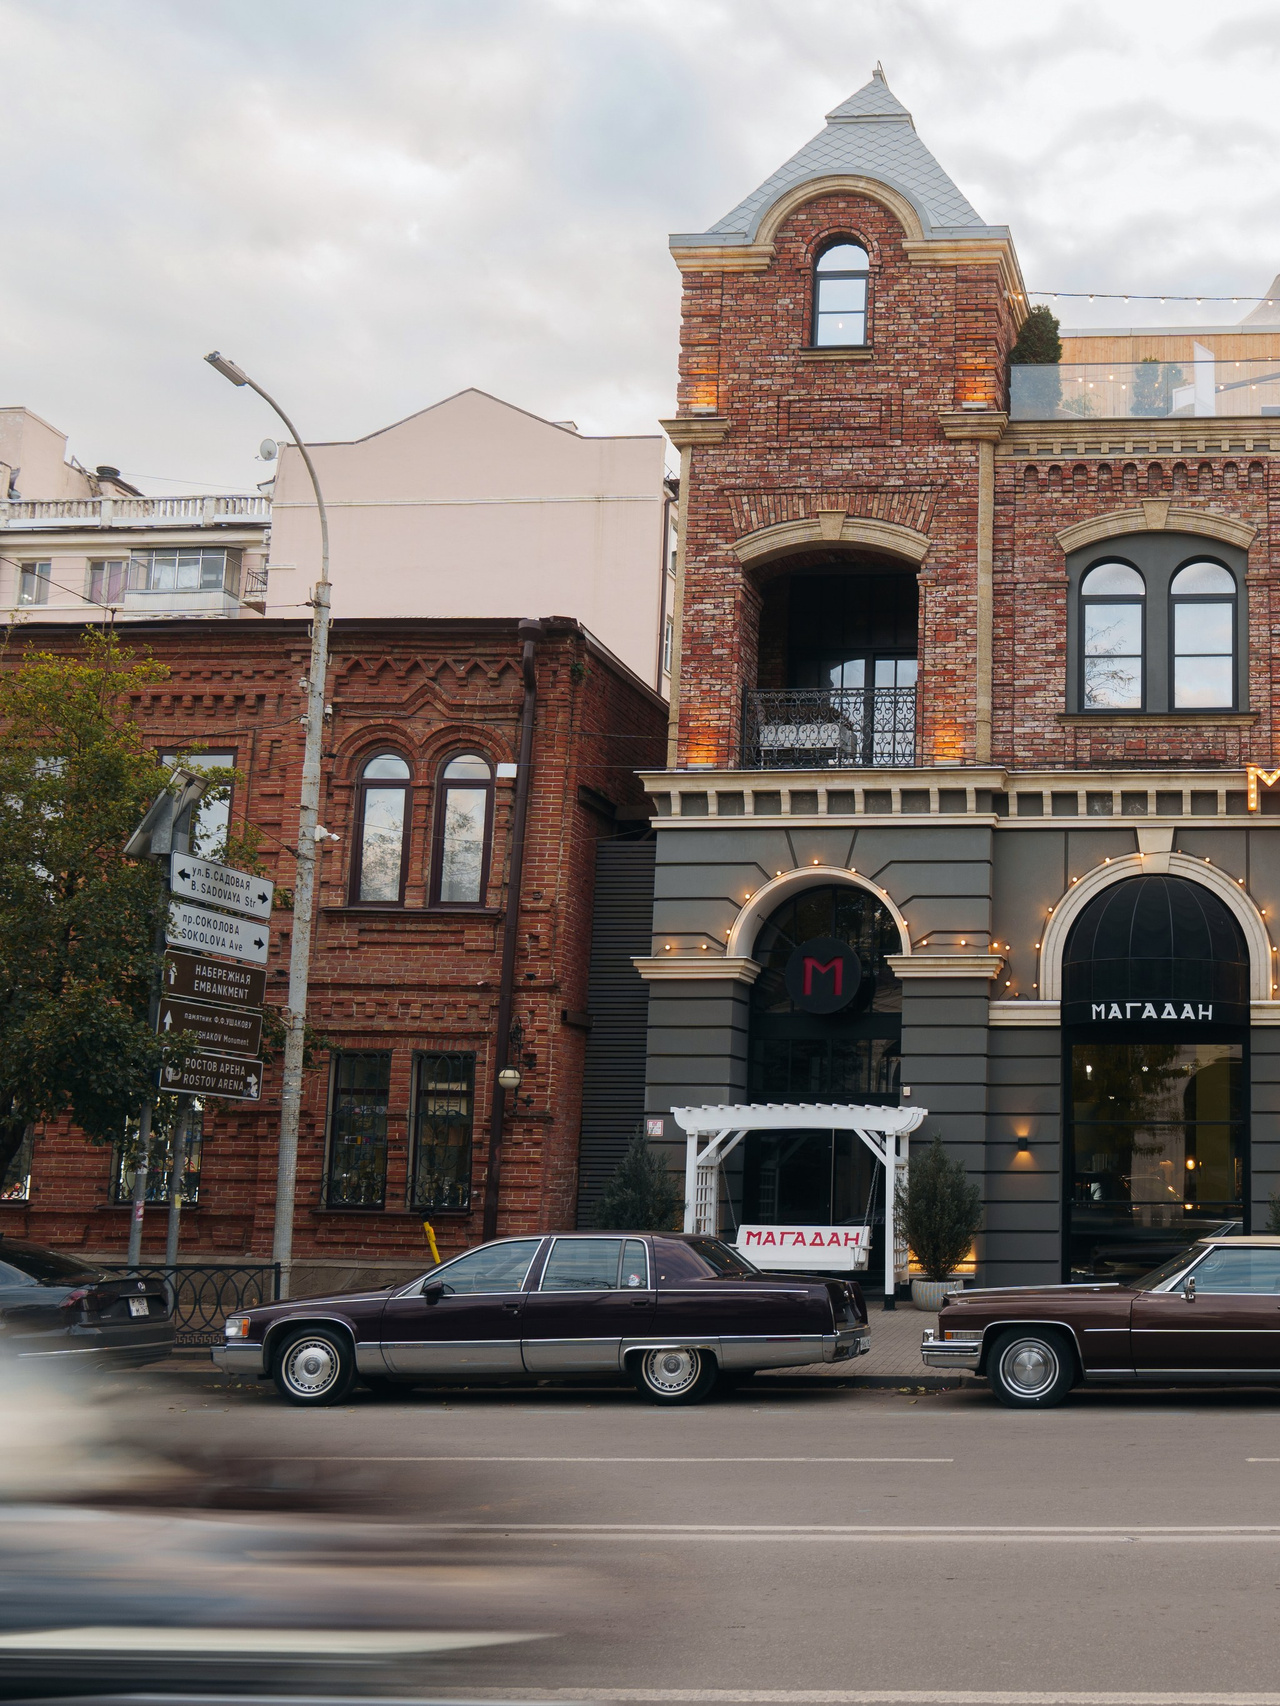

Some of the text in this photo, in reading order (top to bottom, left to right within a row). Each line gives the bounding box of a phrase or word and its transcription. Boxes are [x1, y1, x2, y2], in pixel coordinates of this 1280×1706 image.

[244, 896, 256, 908] Str
[181, 928, 243, 951] SOKOLOVA Ave
[195, 964, 251, 985] НАБЕРЕЖНАЯ
[194, 980, 249, 999] EMBANKMENT
[184, 1012, 213, 1023] памятник
[1091, 1002, 1213, 1020] МАГАДАН
[223, 1034, 249, 1046] Monument
[185, 1057, 246, 1076] РОСТОВ АРЕНА
[183, 1073, 244, 1091] ROSTOV ARENA
[745, 1231, 860, 1247] МАГАДАН
